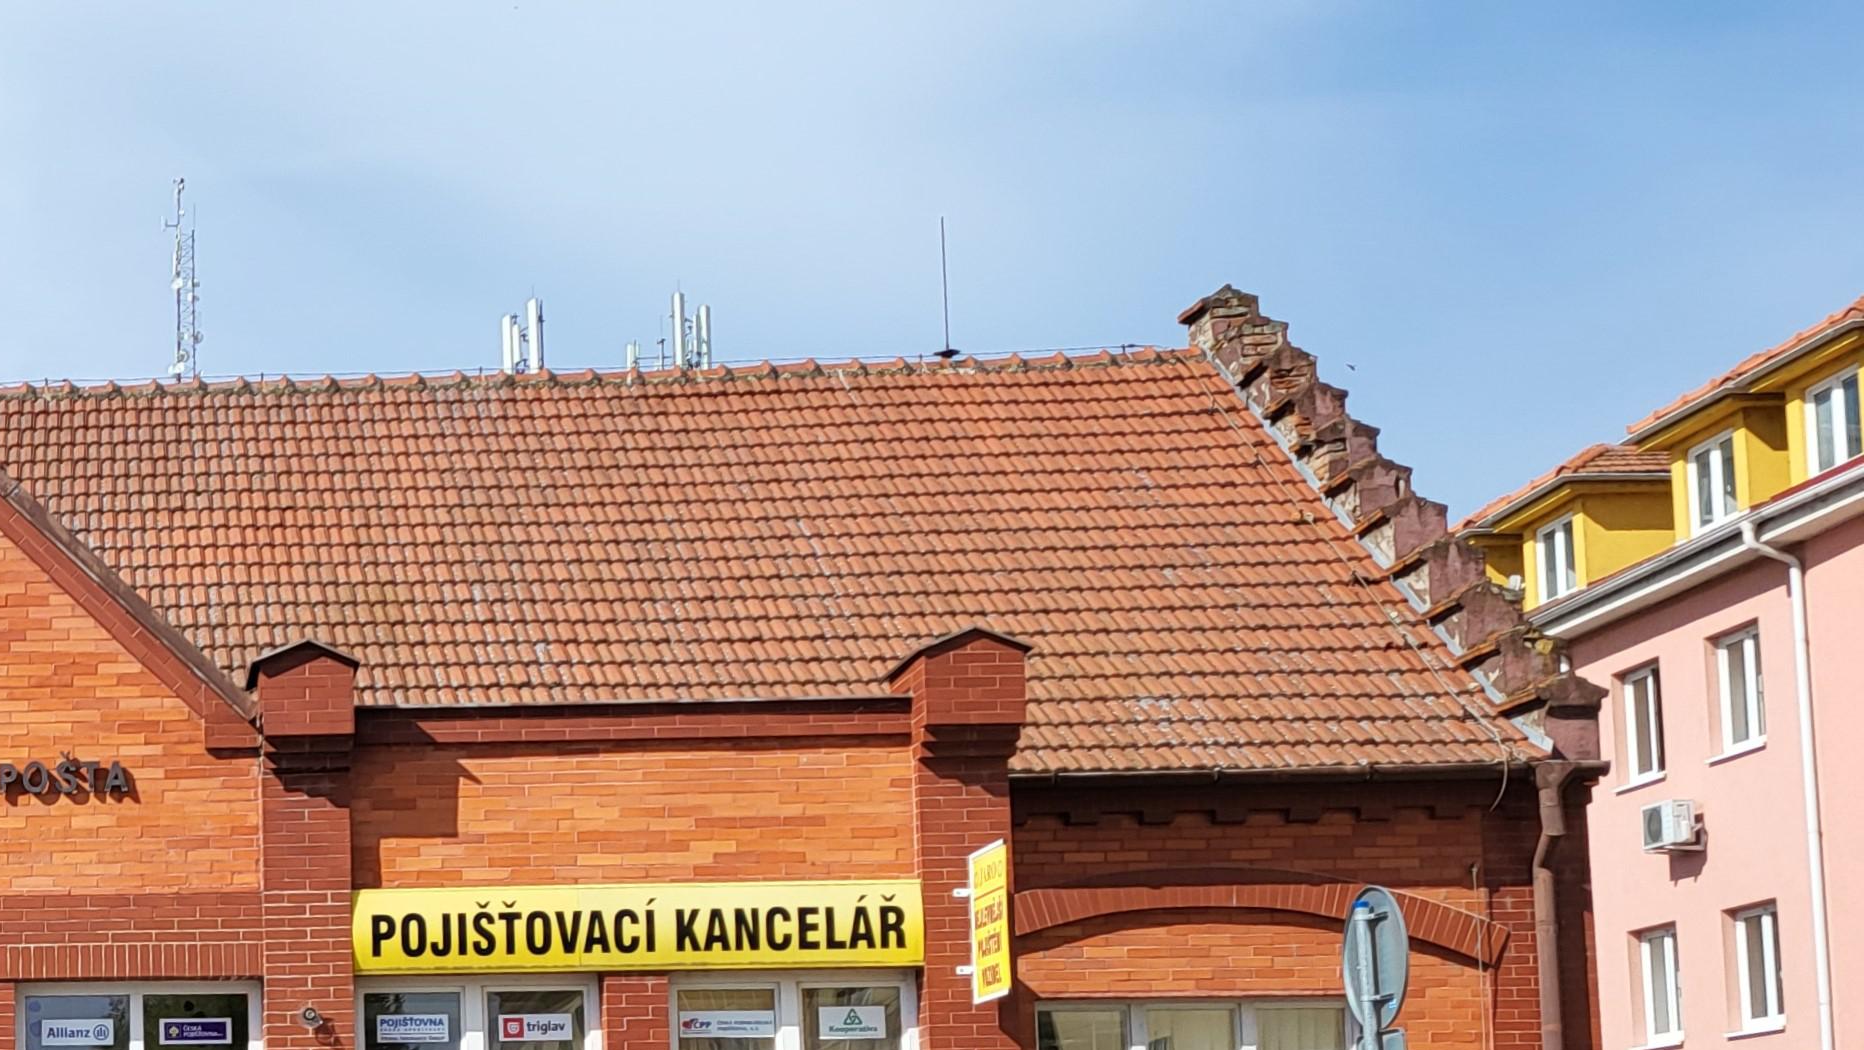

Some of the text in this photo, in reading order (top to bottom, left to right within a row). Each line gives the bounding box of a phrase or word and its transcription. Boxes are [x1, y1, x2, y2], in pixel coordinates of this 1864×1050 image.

[371, 894, 907, 957] POJIŠŤOVACÍ KANCELÁŘ
[380, 1016, 444, 1028] POJIŠŤOVNA
[527, 1021, 566, 1035] triglav
[47, 1027, 92, 1039] Allianz
